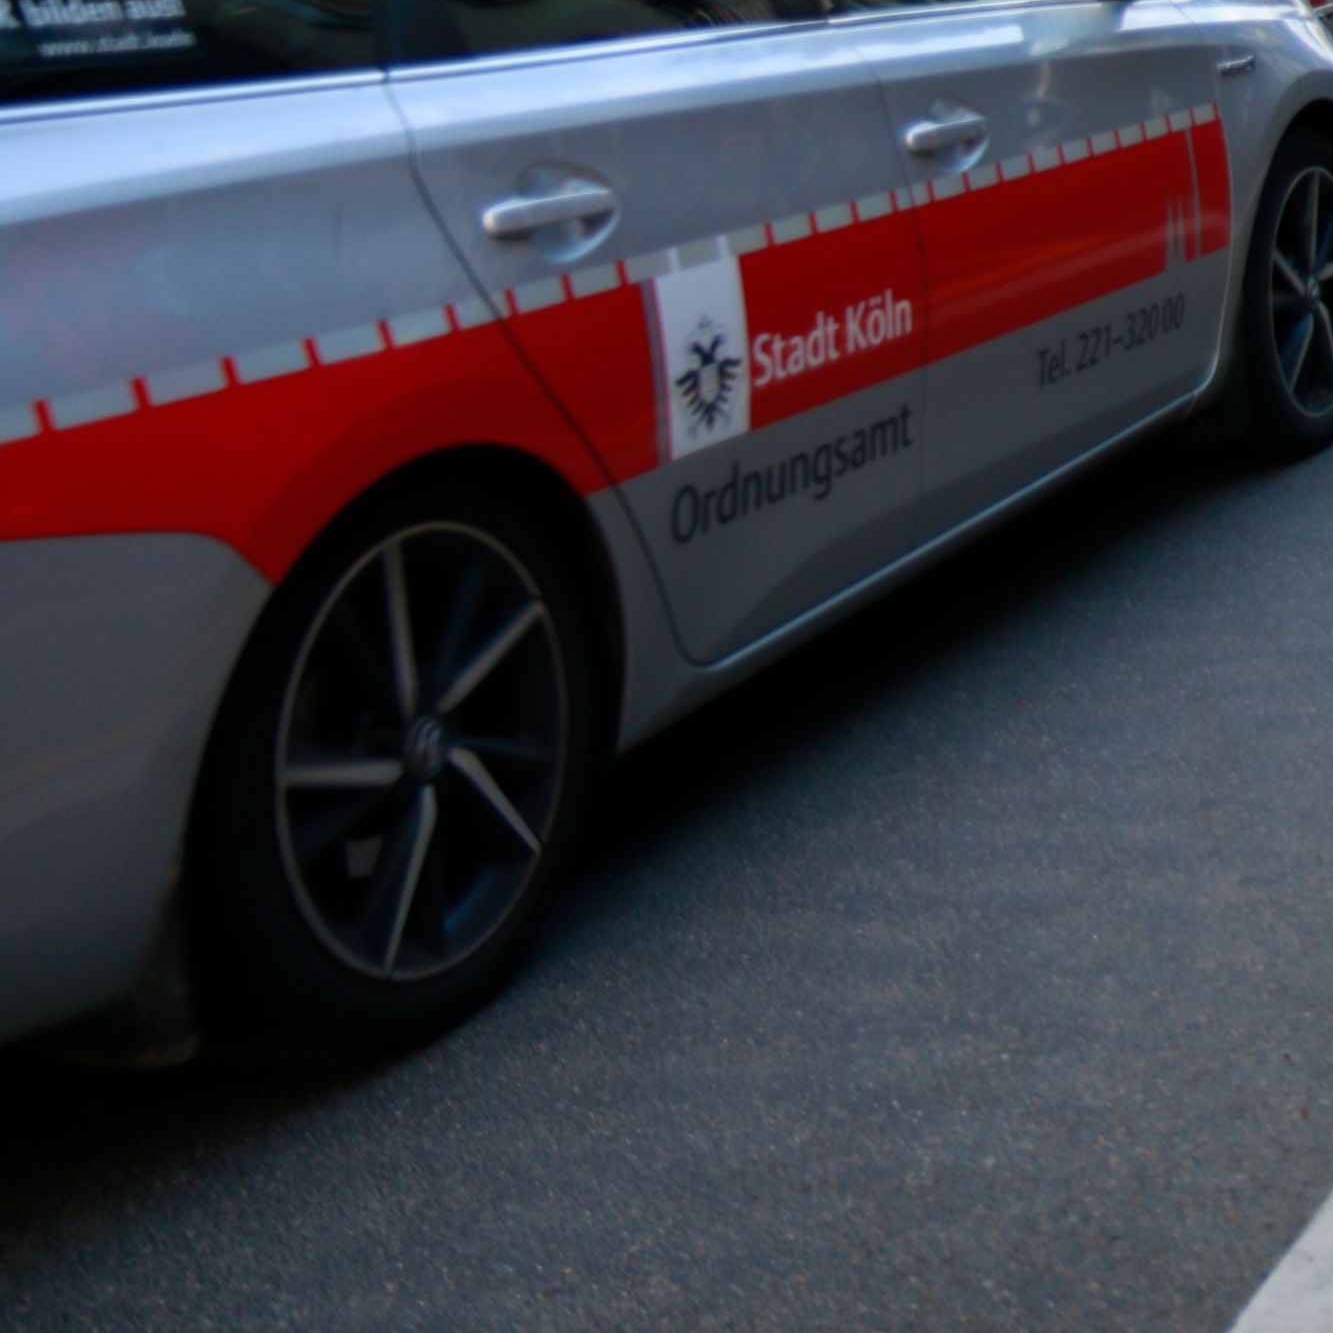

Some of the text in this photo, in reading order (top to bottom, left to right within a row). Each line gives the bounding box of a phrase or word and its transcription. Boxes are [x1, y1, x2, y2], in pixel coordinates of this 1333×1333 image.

[753, 288, 913, 387] Stadt Köln
[1036, 337, 1072, 388] Tel.
[671, 402, 913, 546] Ordnungsamt
